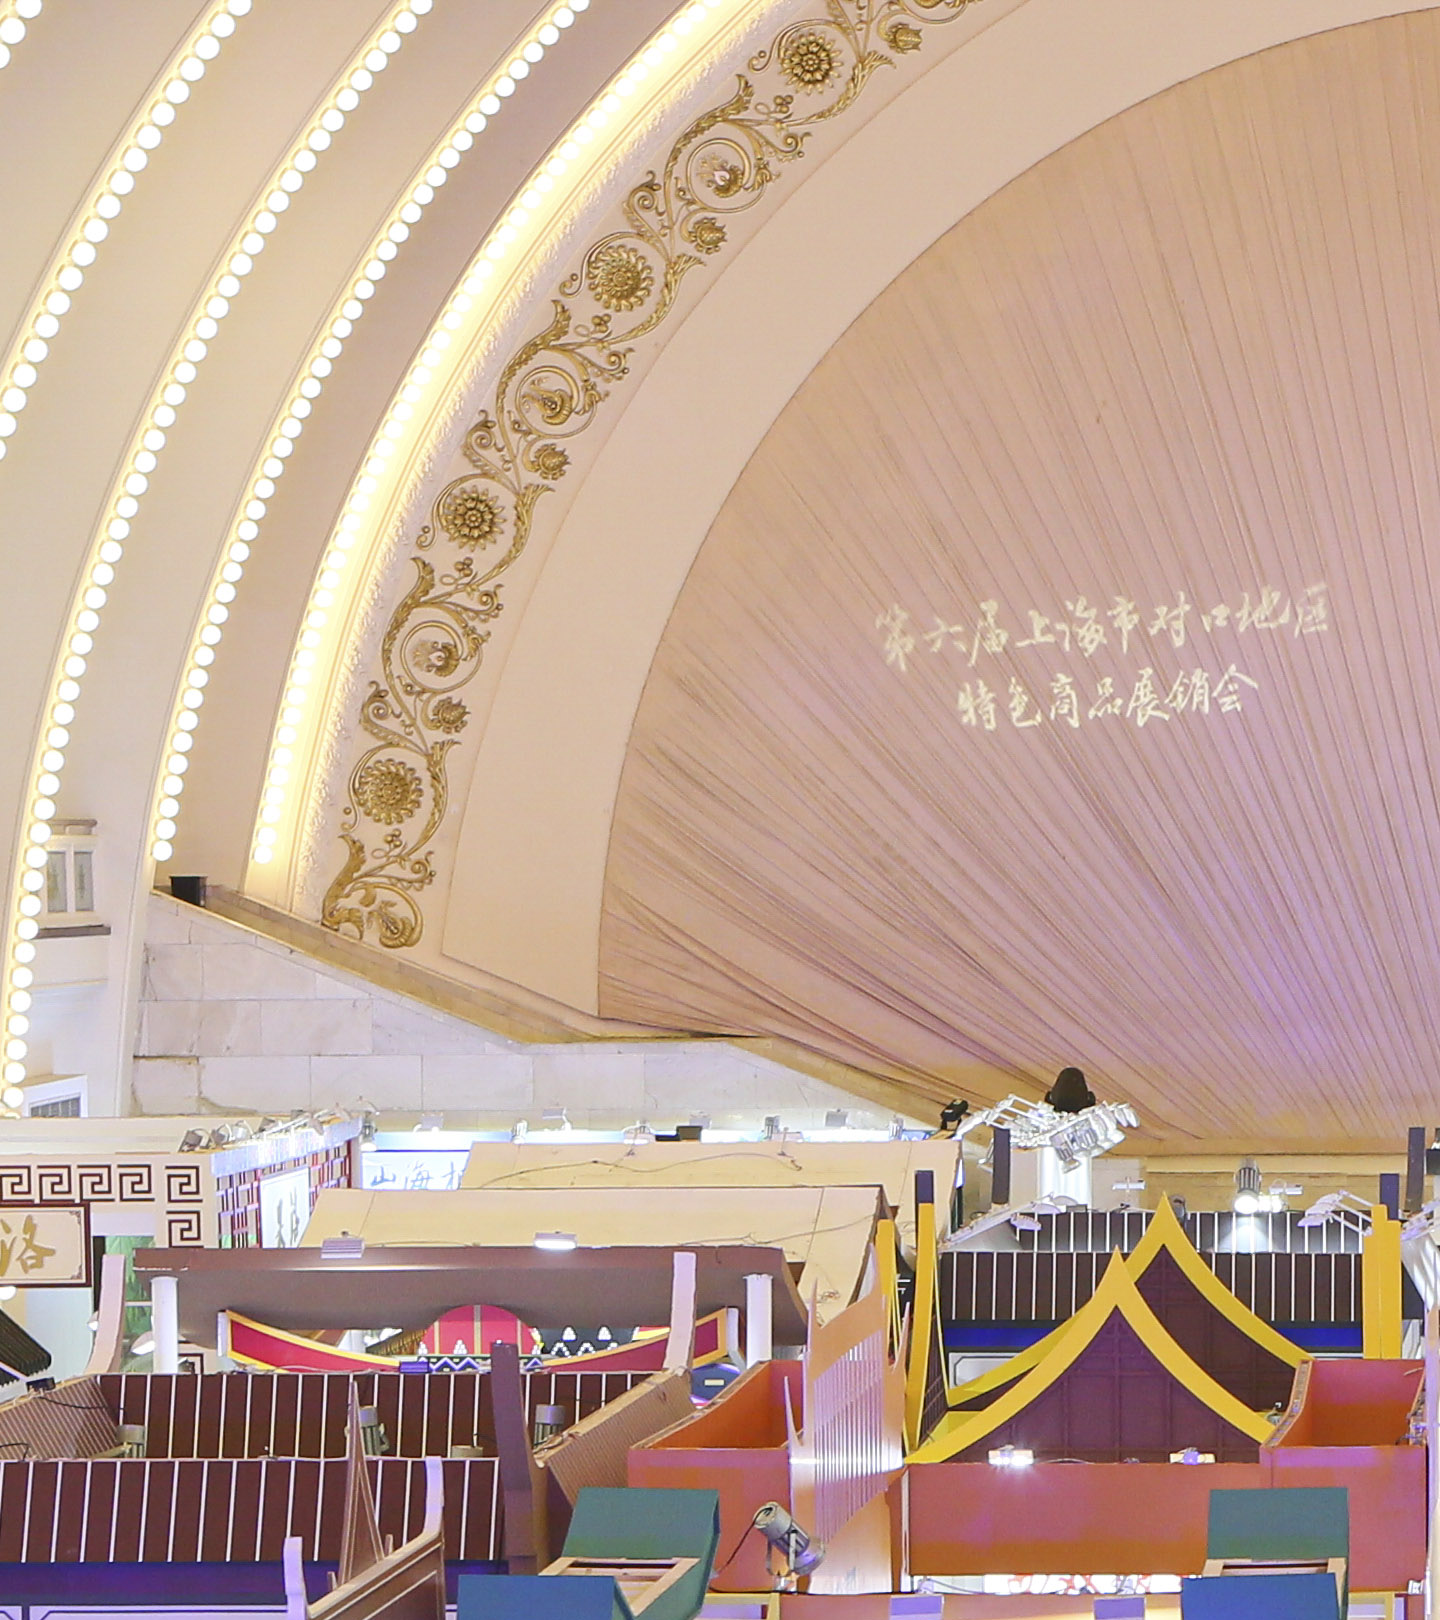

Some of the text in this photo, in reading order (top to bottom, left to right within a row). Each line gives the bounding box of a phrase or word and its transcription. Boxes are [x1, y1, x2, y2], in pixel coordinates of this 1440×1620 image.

[876, 583, 1328, 671] 第六届上海市对口地区
[957, 664, 1259, 731] 特色商品展销会
